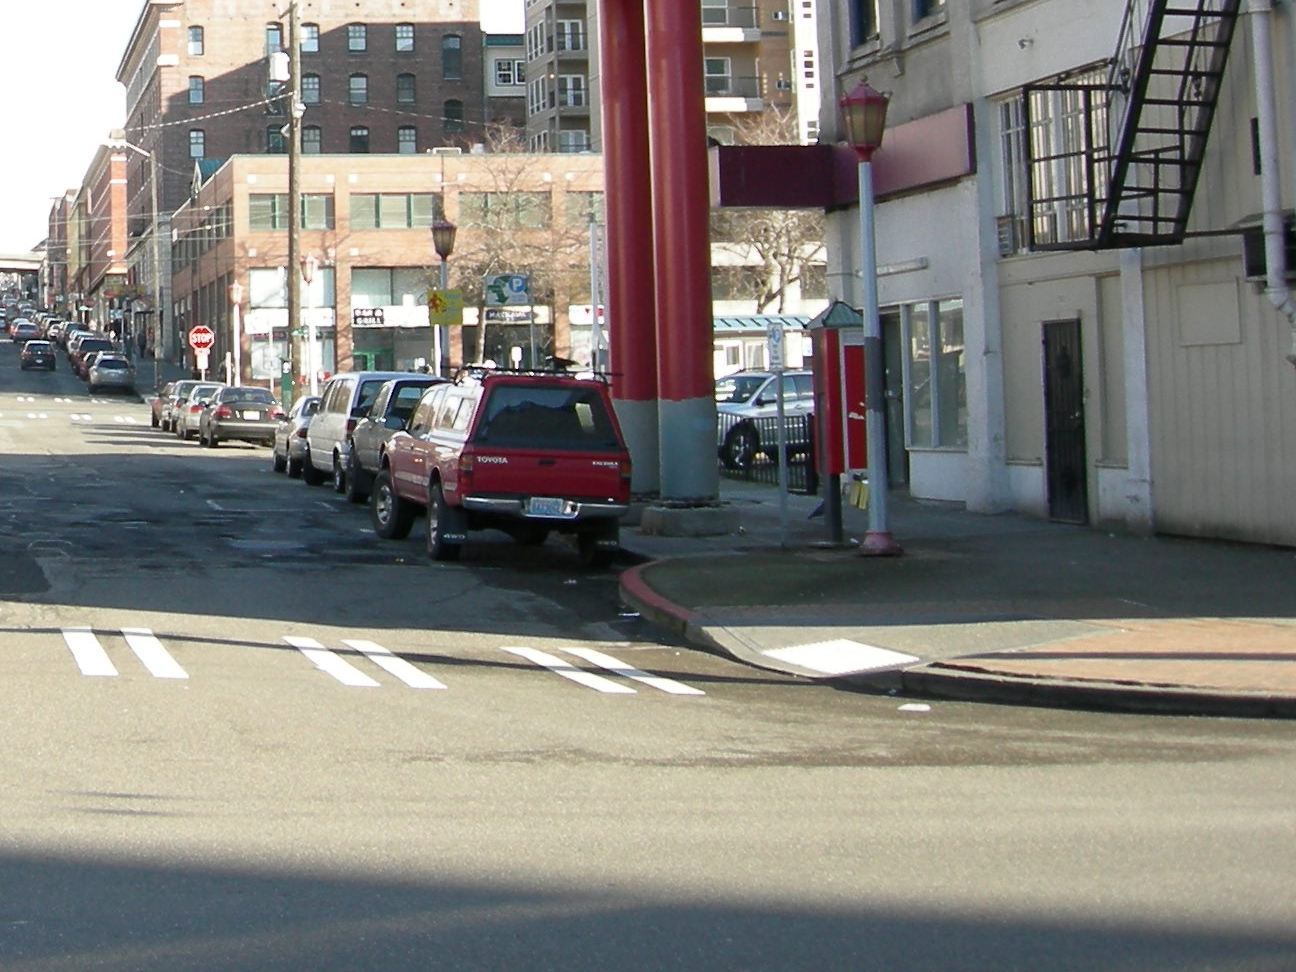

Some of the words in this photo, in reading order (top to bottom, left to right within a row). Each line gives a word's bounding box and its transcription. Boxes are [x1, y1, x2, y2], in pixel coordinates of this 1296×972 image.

[512, 278, 522, 291] P
[191, 332, 212, 344] STOP
[477, 456, 508, 464] TOYOTA
